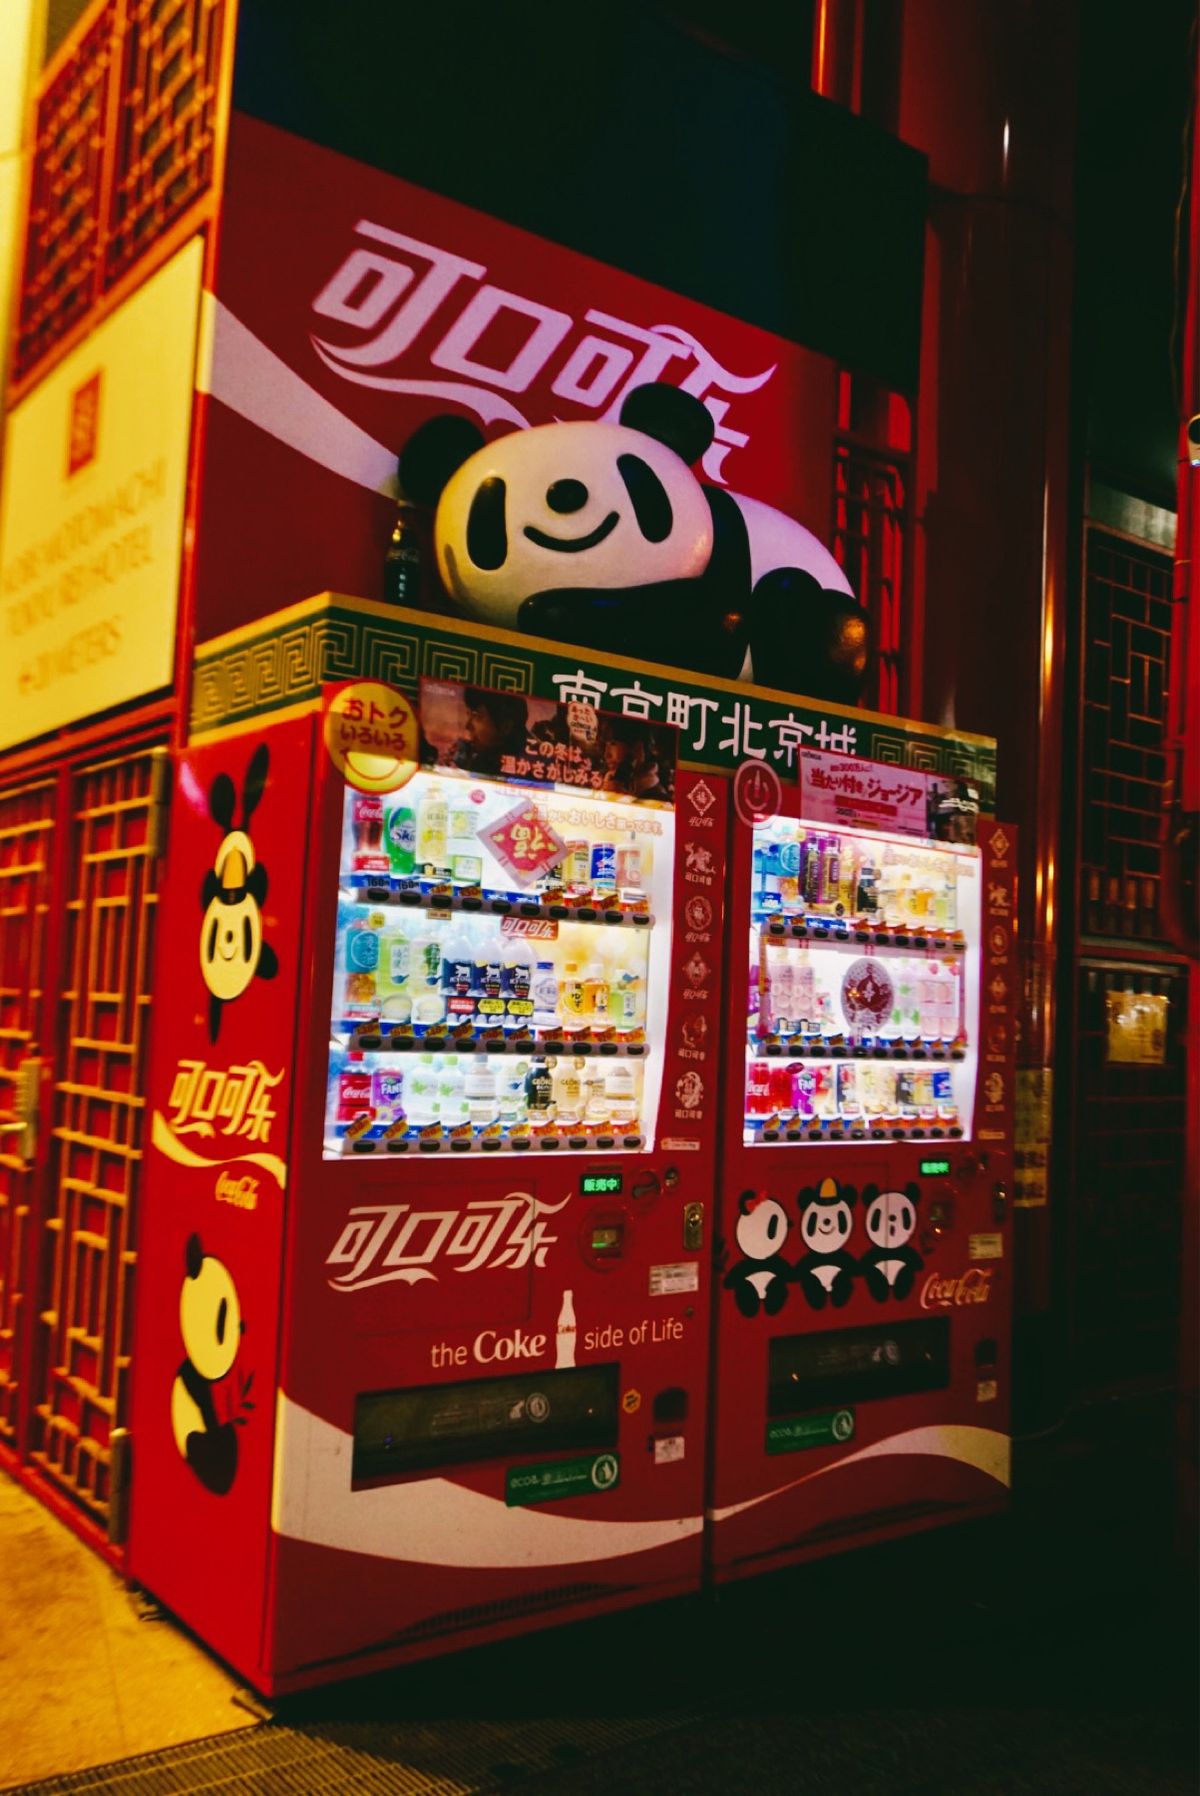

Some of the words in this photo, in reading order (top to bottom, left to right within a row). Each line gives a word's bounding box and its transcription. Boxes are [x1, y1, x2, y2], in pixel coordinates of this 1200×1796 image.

[342, 698, 408, 729] おトク
[339, 722, 407, 753] いろいろ
[168, 1060, 286, 1143] 可口可乐
[326, 1192, 572, 1291] 可口可乐
[431, 1342, 468, 1368] the
[473, 1329, 547, 1363] Coke
[584, 1326, 624, 1350] side
[629, 1319, 648, 1345] of
[652, 1317, 684, 1342] Life
